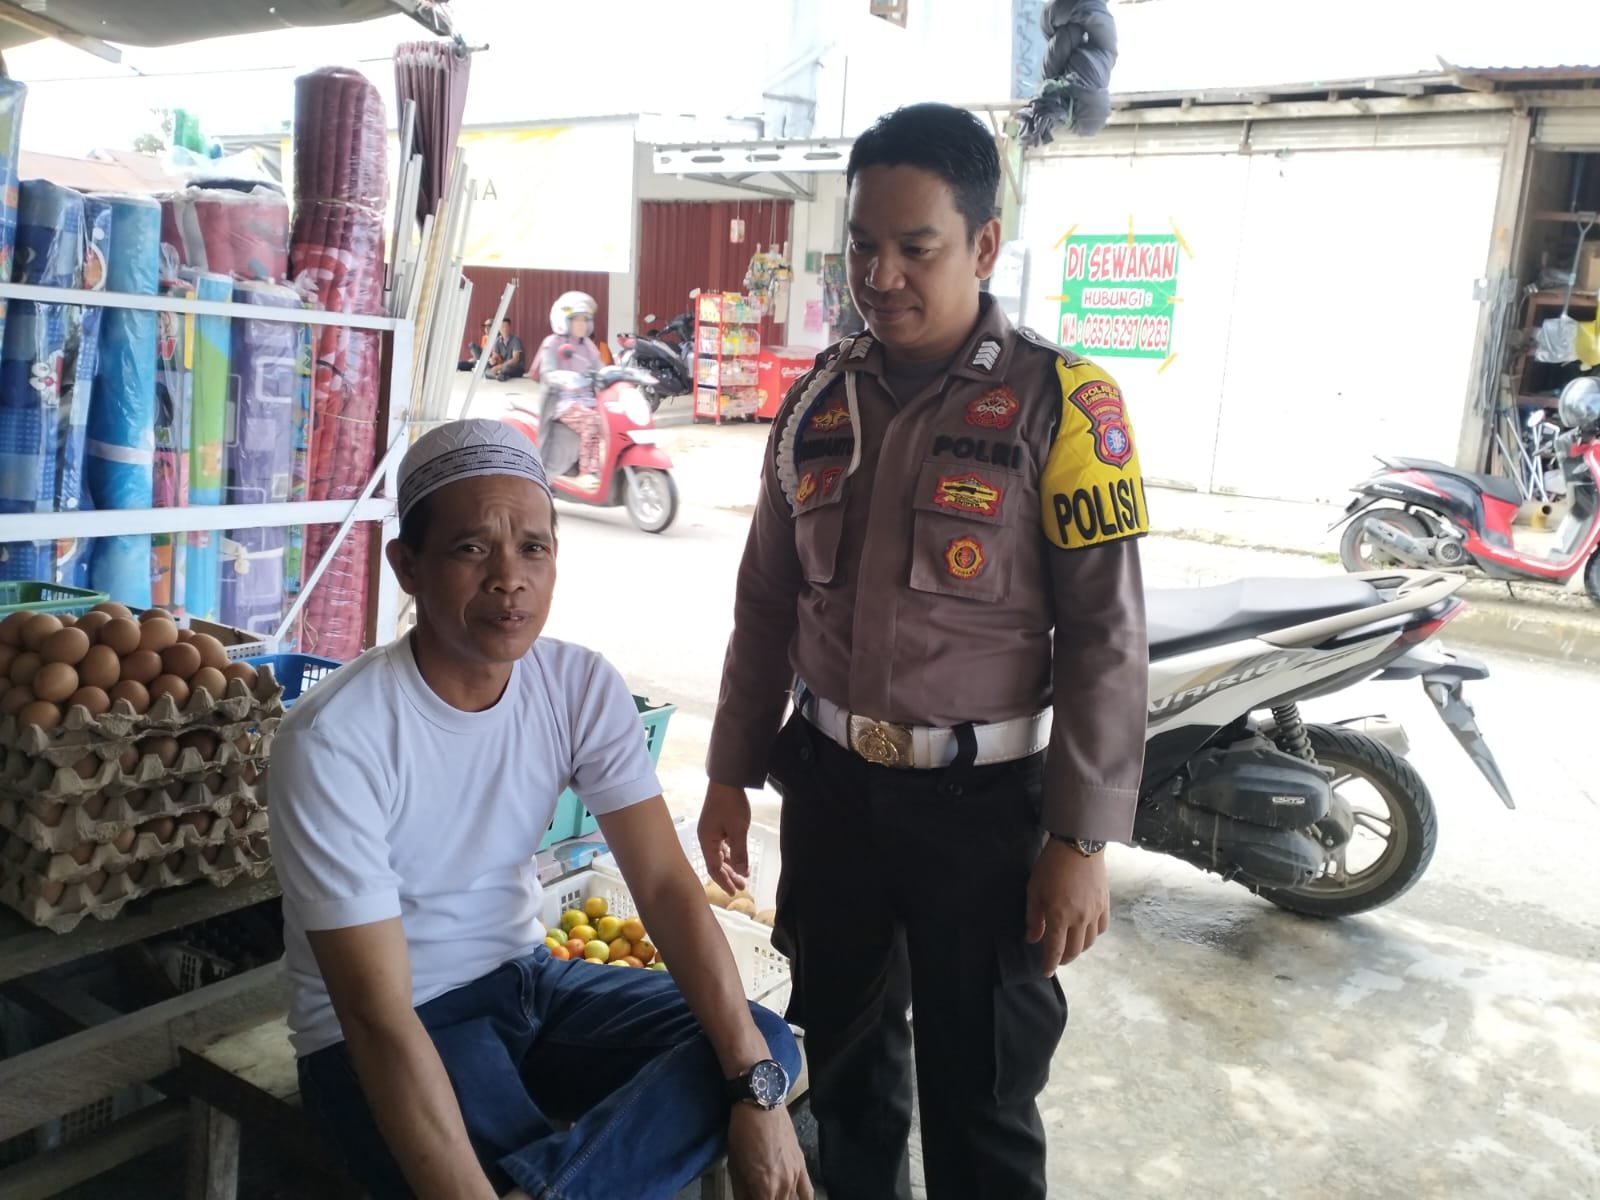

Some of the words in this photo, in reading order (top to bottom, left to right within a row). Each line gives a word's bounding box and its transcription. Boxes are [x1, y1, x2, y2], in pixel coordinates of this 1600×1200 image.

[1066, 244, 1086, 279] DI
[1089, 244, 1177, 280] SEWAKAN
[1083, 315, 1111, 347] 0852
[1112, 317, 1139, 348] 5297
[1140, 317, 1169, 349] 0283
[931, 434, 1022, 470] POLRI
[1053, 478, 1140, 545] POLISI
[1148, 656, 1289, 714] VARIO
